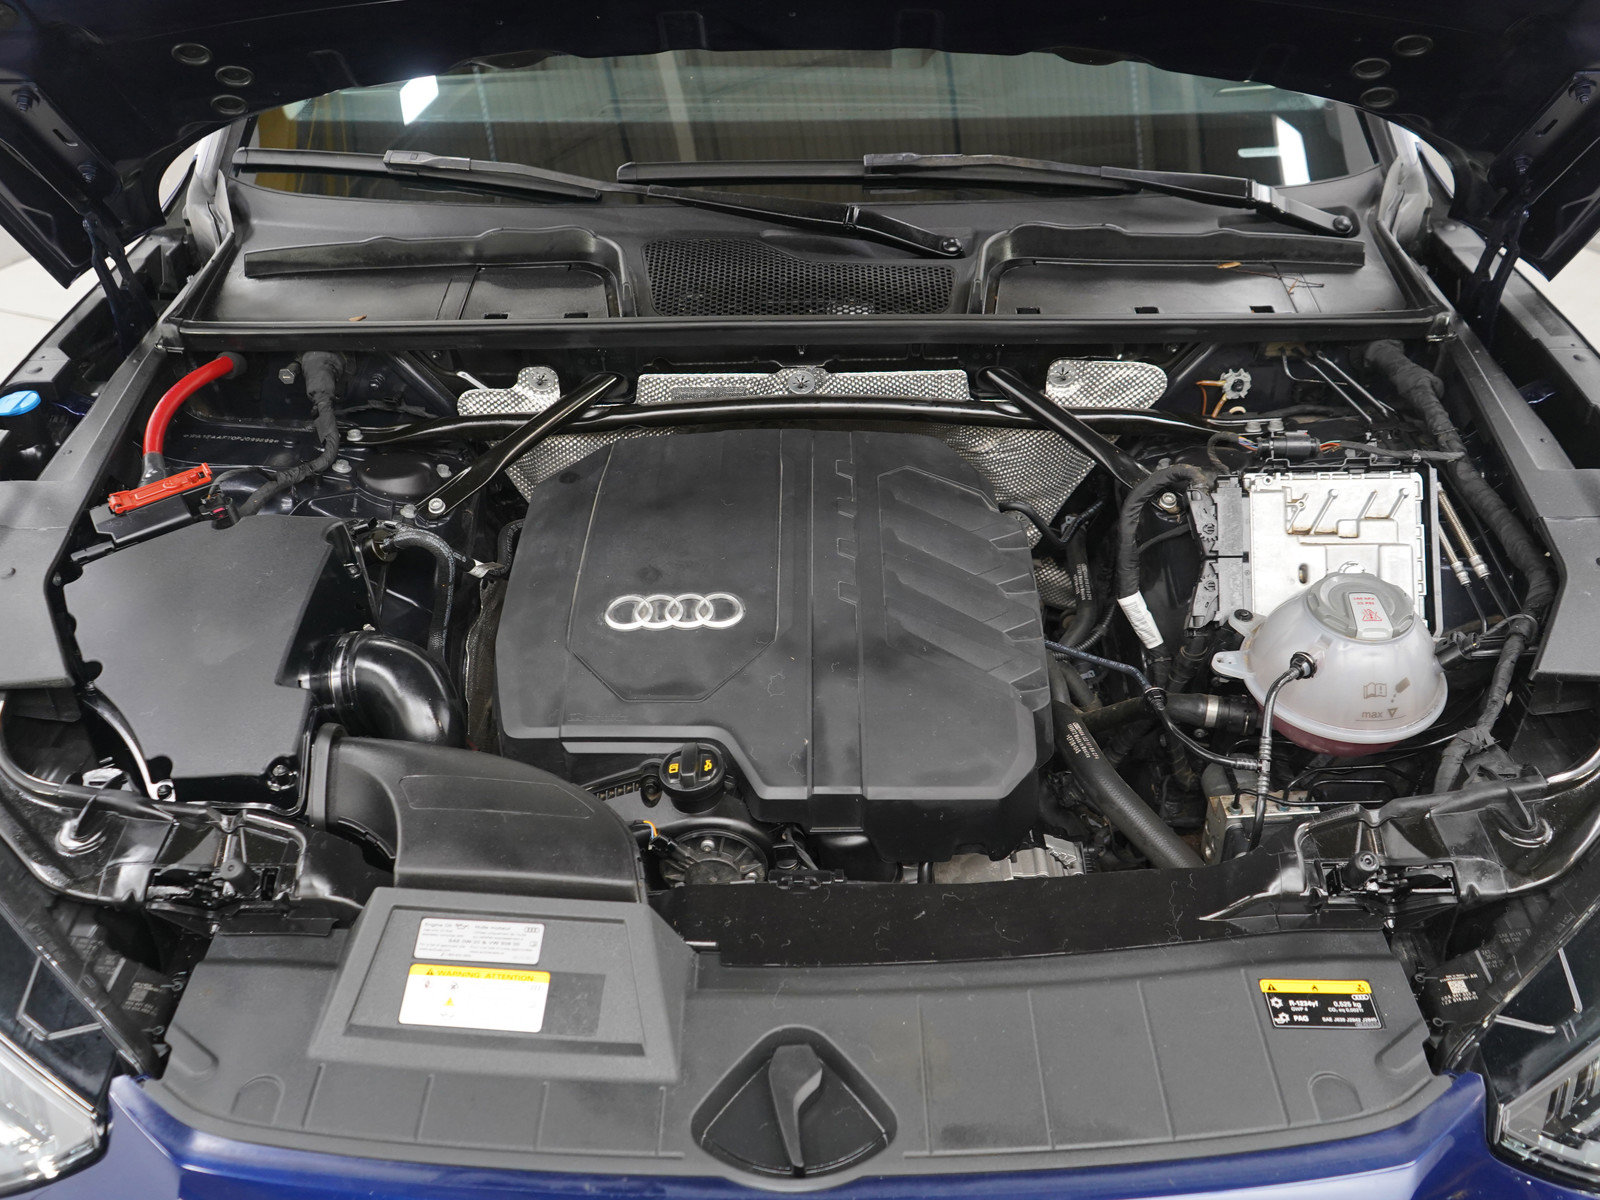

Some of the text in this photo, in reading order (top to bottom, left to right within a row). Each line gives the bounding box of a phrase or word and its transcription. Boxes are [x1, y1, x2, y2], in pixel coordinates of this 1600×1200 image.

[437, 970, 534, 982] WARNING ATTENTION
[1288, 1000, 1318, 1008] R-1234yf
[1353, 1001, 1362, 1009] kg
